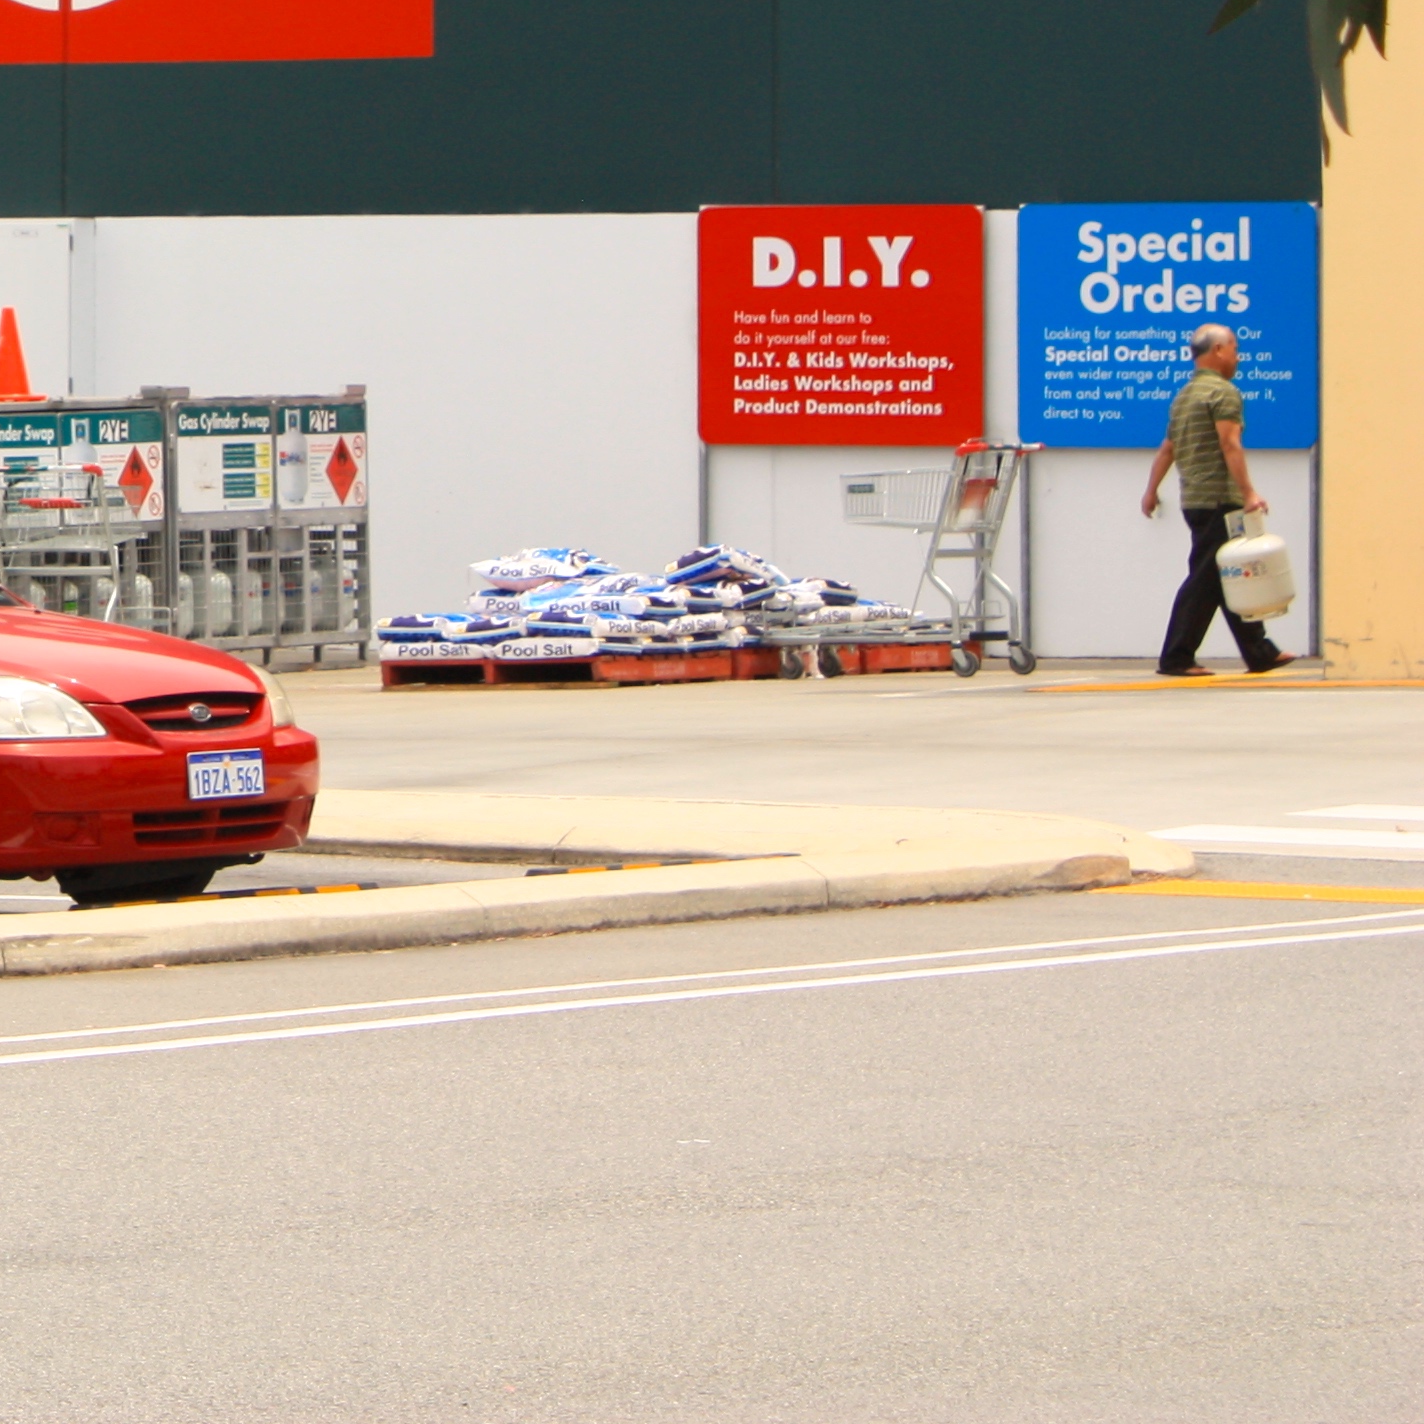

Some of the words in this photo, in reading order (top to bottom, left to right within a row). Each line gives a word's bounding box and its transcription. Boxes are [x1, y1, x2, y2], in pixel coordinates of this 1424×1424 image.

[1077, 216, 1251, 276] Special
[752, 236, 931, 288] D.I.Y.
[1079, 268, 1251, 314] Orders
[733, 310, 767, 324] Have
[770, 309, 790, 324] fun
[794, 309, 819, 324] and
[822, 309, 855, 324] learn
[859, 312, 872, 324] to
[733, 330, 751, 345] do
[754, 331, 763, 345] it
[767, 330, 817, 348] yourself
[819, 332, 833, 345] at
[836, 334, 858, 345] our
[861, 330, 891, 345] free:
[1044, 326, 1090, 343] Looking
[1094, 326, 1111, 340] for
[1115, 326, 1177, 343] something
[1237, 326, 1262, 340] Our
[734, 352, 781, 368] D.I.Y.
[786, 352, 801, 368] &
[806, 351, 845, 368] Kids
[849, 351, 955, 372] Workshops,
[1045, 344, 1109, 366] Special
[1114, 344, 1177, 362] Orders
[1237, 352, 1252, 362] as
[1255, 352, 1273, 361] an
[1044, 370, 1074, 380] even
[1078, 367, 1113, 380] wider
[1116, 370, 1154, 384] range
[1157, 365, 1170, 380] of
[1247, 366, 1293, 380] choose
[734, 375, 789, 391] Ladies
[794, 375, 894, 396] Workshops
[899, 375, 934, 392] and
[1044, 385, 1072, 400] from
[1076, 386, 1101, 400] and
[1138, 386, 1172, 400] order
[734, 397, 800, 414] Product
[805, 398, 944, 415] Demonstrations
[1043, 405, 1079, 419] direct
[1082, 408, 1095, 419] to
[1098, 409, 1124, 423] you.
[178, 413, 198, 430] Gas
[200, 411, 240, 434] Cylinder
[241, 412, 270, 433] Swap
[24, 424, 55, 445] Swap
[488, 565, 524, 577] Pool
[529, 563, 558, 576] Salt
[485, 598, 520, 610] Pool
[548, 602, 586, 613] Pool
[590, 600, 621, 612] Salt
[867, 607, 888, 620] Pool
[609, 621, 633, 634] Pool
[634, 621, 655, 634] Salt
[398, 644, 434, 657] Pool
[439, 643, 470, 656] Salt
[501, 644, 538, 657] Pool
[543, 643, 574, 656] Salt
